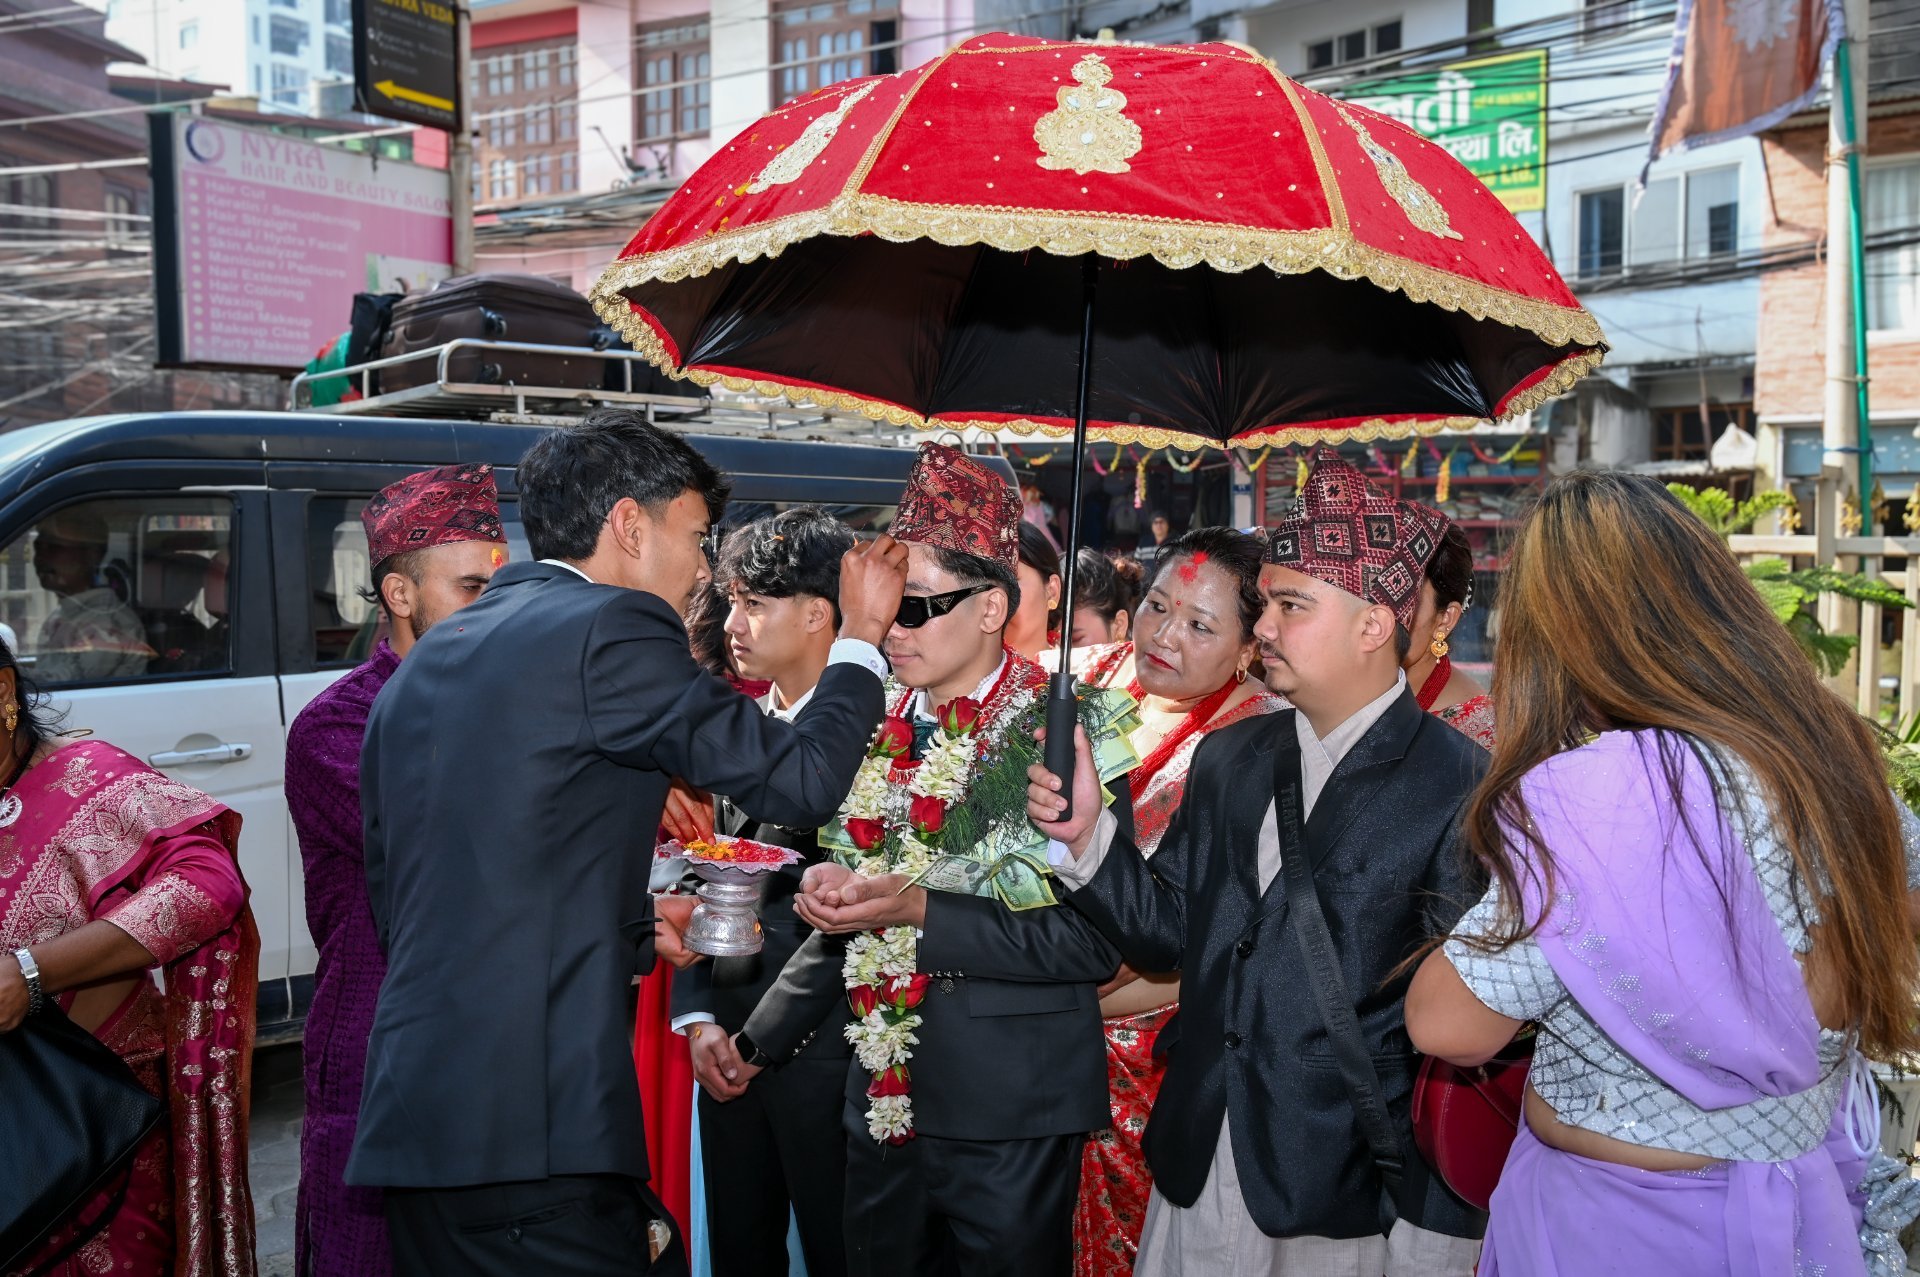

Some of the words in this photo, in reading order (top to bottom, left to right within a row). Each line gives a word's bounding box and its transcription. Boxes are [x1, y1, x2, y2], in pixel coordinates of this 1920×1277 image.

[241, 131, 326, 172] NYRA
[206, 179, 236, 194] Hair
[240, 185, 267, 200] Cut
[241, 160, 286, 183] HAIR
[293, 171, 328, 191] AND
[335, 177, 399, 202] BEAUTY
[206, 193, 260, 212] Keratin
[207, 208, 238, 222] Hair
[242, 214, 298, 233] Straight
[208, 222, 251, 240] Facial
[308, 236, 349, 254] Facial
[208, 236, 241, 251] Skin
[245, 241, 307, 260] Analyzer
[208, 251, 276, 270] Manicure
[288, 260, 347, 277] Pedicure
[208, 265, 239, 279] Nail
[242, 268, 312, 287] Extension
[208, 279, 240, 293] Hair
[244, 283, 305, 302] Coloring
[209, 293, 264, 311] Waxing
[210, 307, 255, 322] Bridal
[258, 312, 312, 329] Makeup
[210, 321, 268, 338] Makeup
[272, 325, 310, 340] Class
[211, 335, 249, 352] Party
